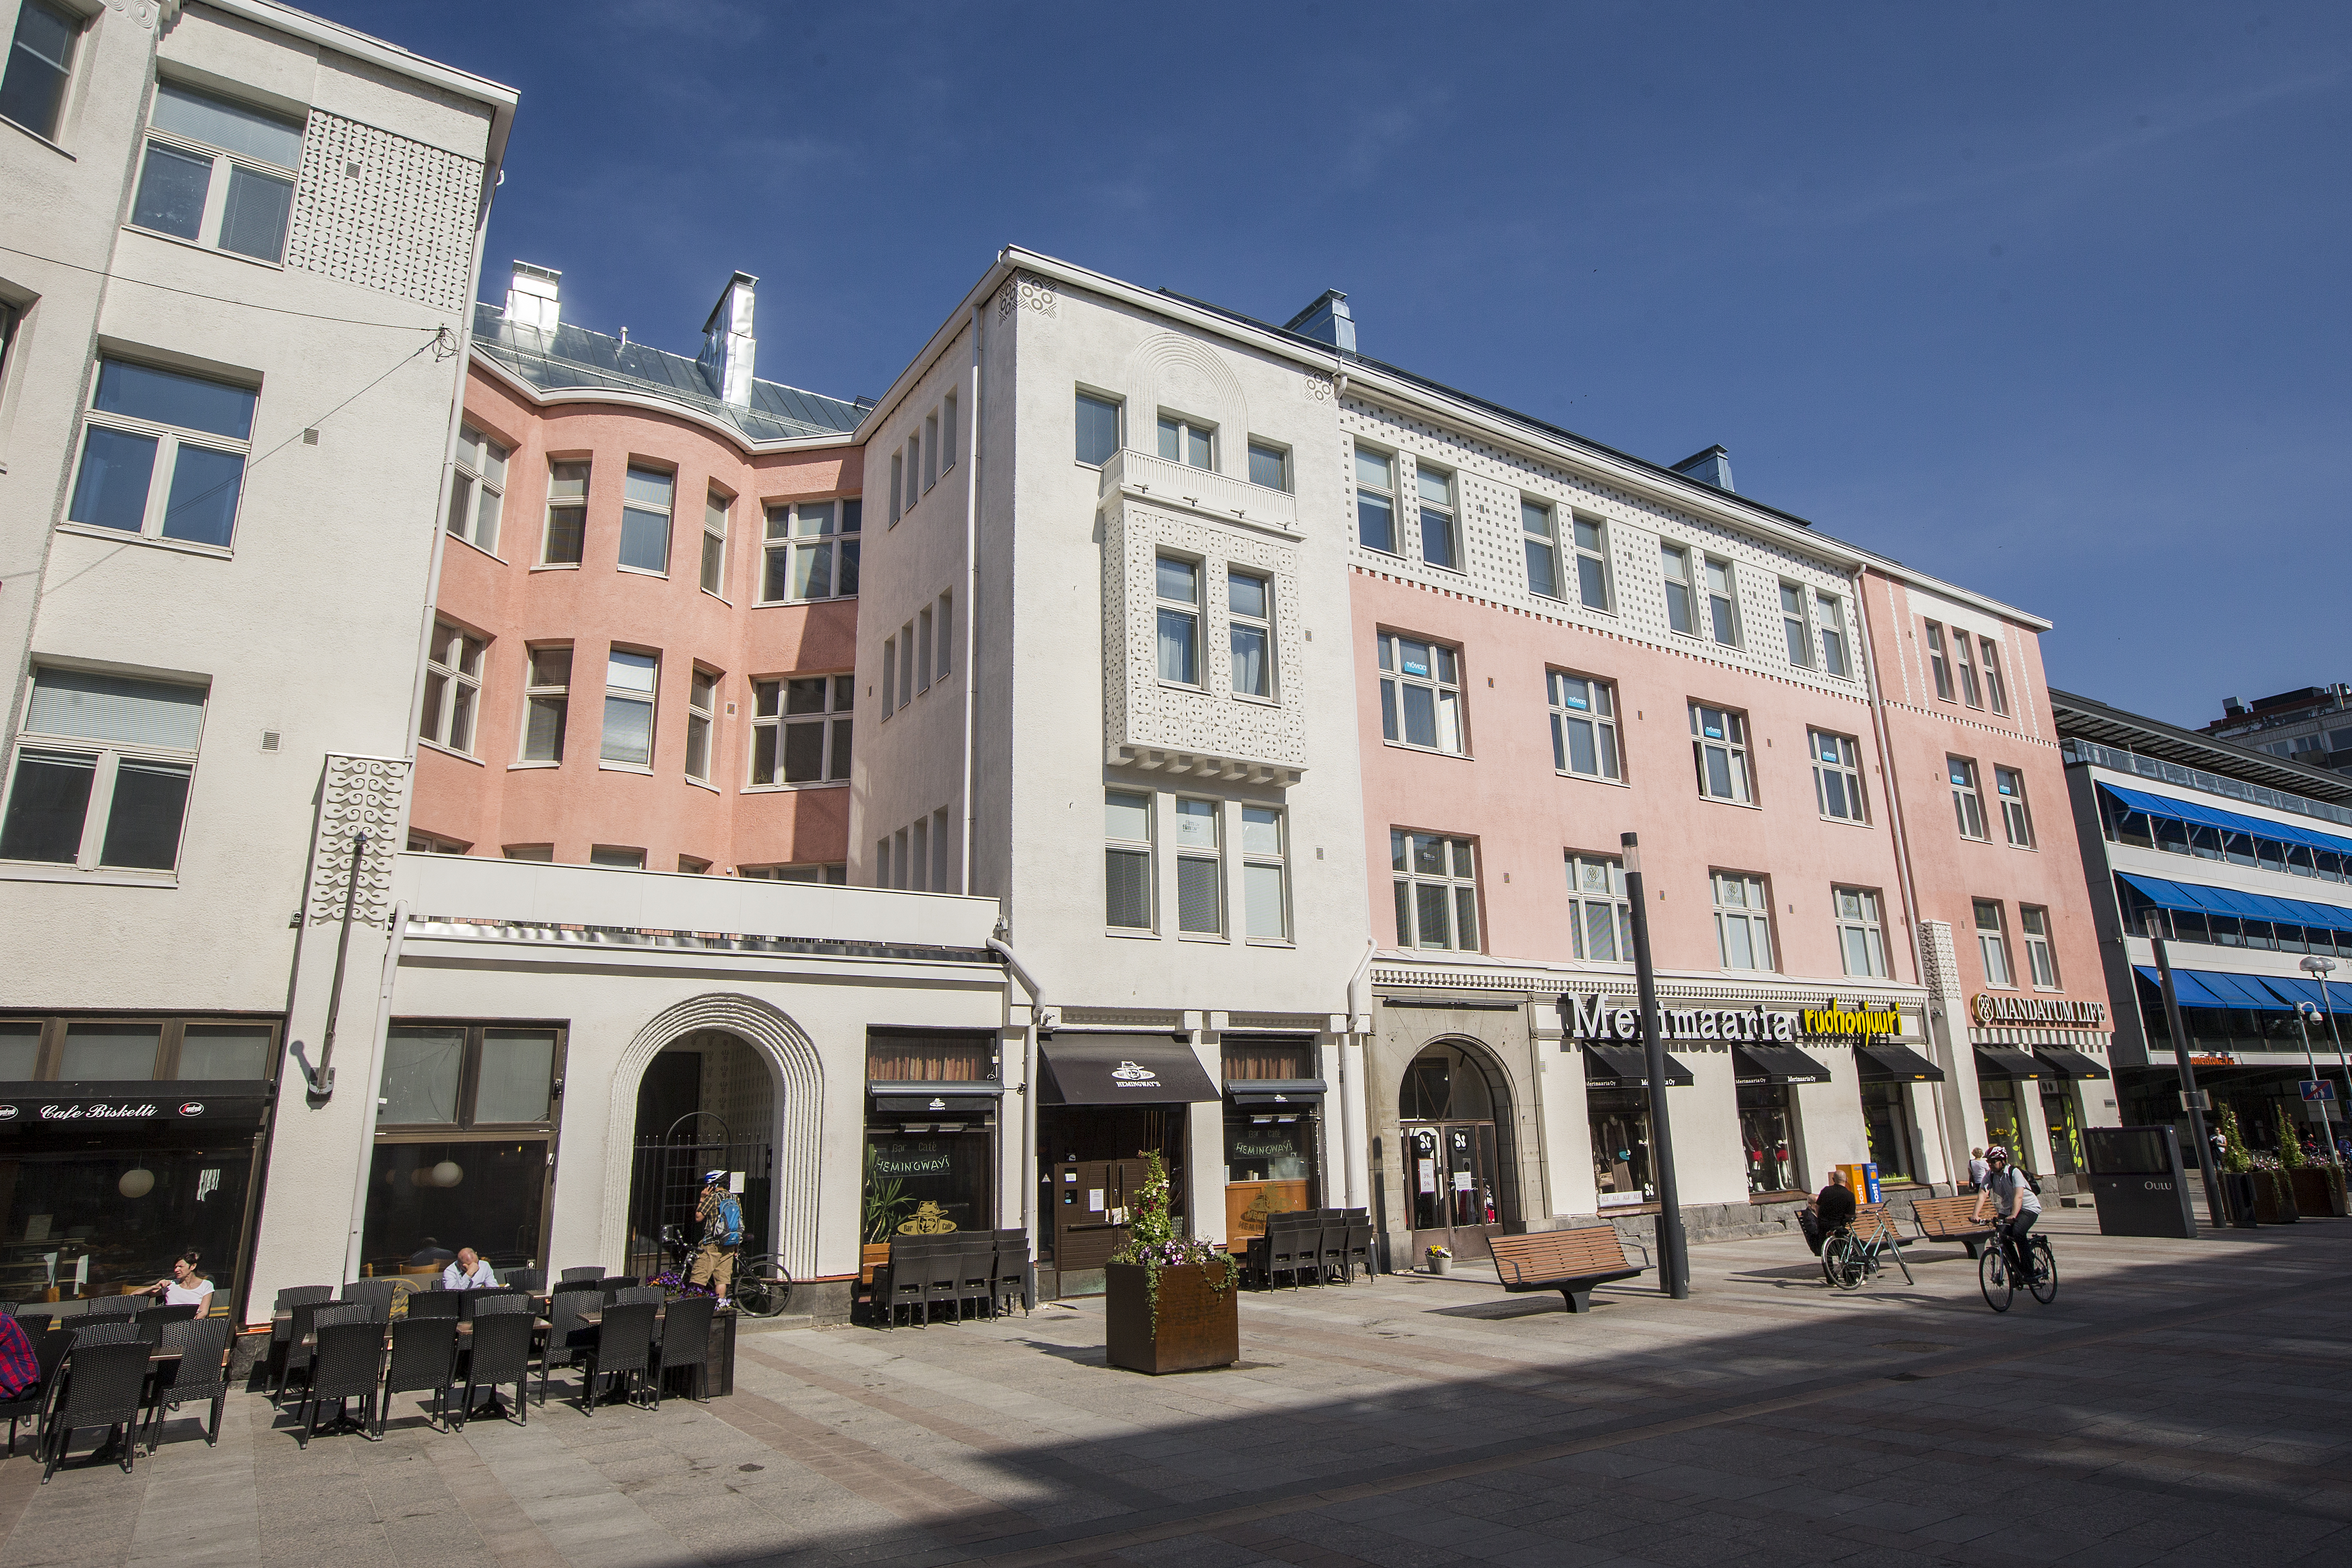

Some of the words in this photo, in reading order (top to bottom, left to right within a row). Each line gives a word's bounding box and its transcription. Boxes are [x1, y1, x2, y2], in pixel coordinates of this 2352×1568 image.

[1568, 992, 1792, 1041] Meimaaria
[1993, 997, 2076, 1021] MANDATUM
[2076, 1001, 2106, 1022] LIFE
[1804, 997, 1902, 1047] ruohonjuuri
[40, 1105, 85, 1119] Cafe
[86, 1104, 158, 1118] Bisketti
[1267, 1129, 1281, 1138] Café
[892, 1144, 907, 1153] Bar
[918, 1141, 937, 1152] Café
[942, 1222, 953, 1230] Café
